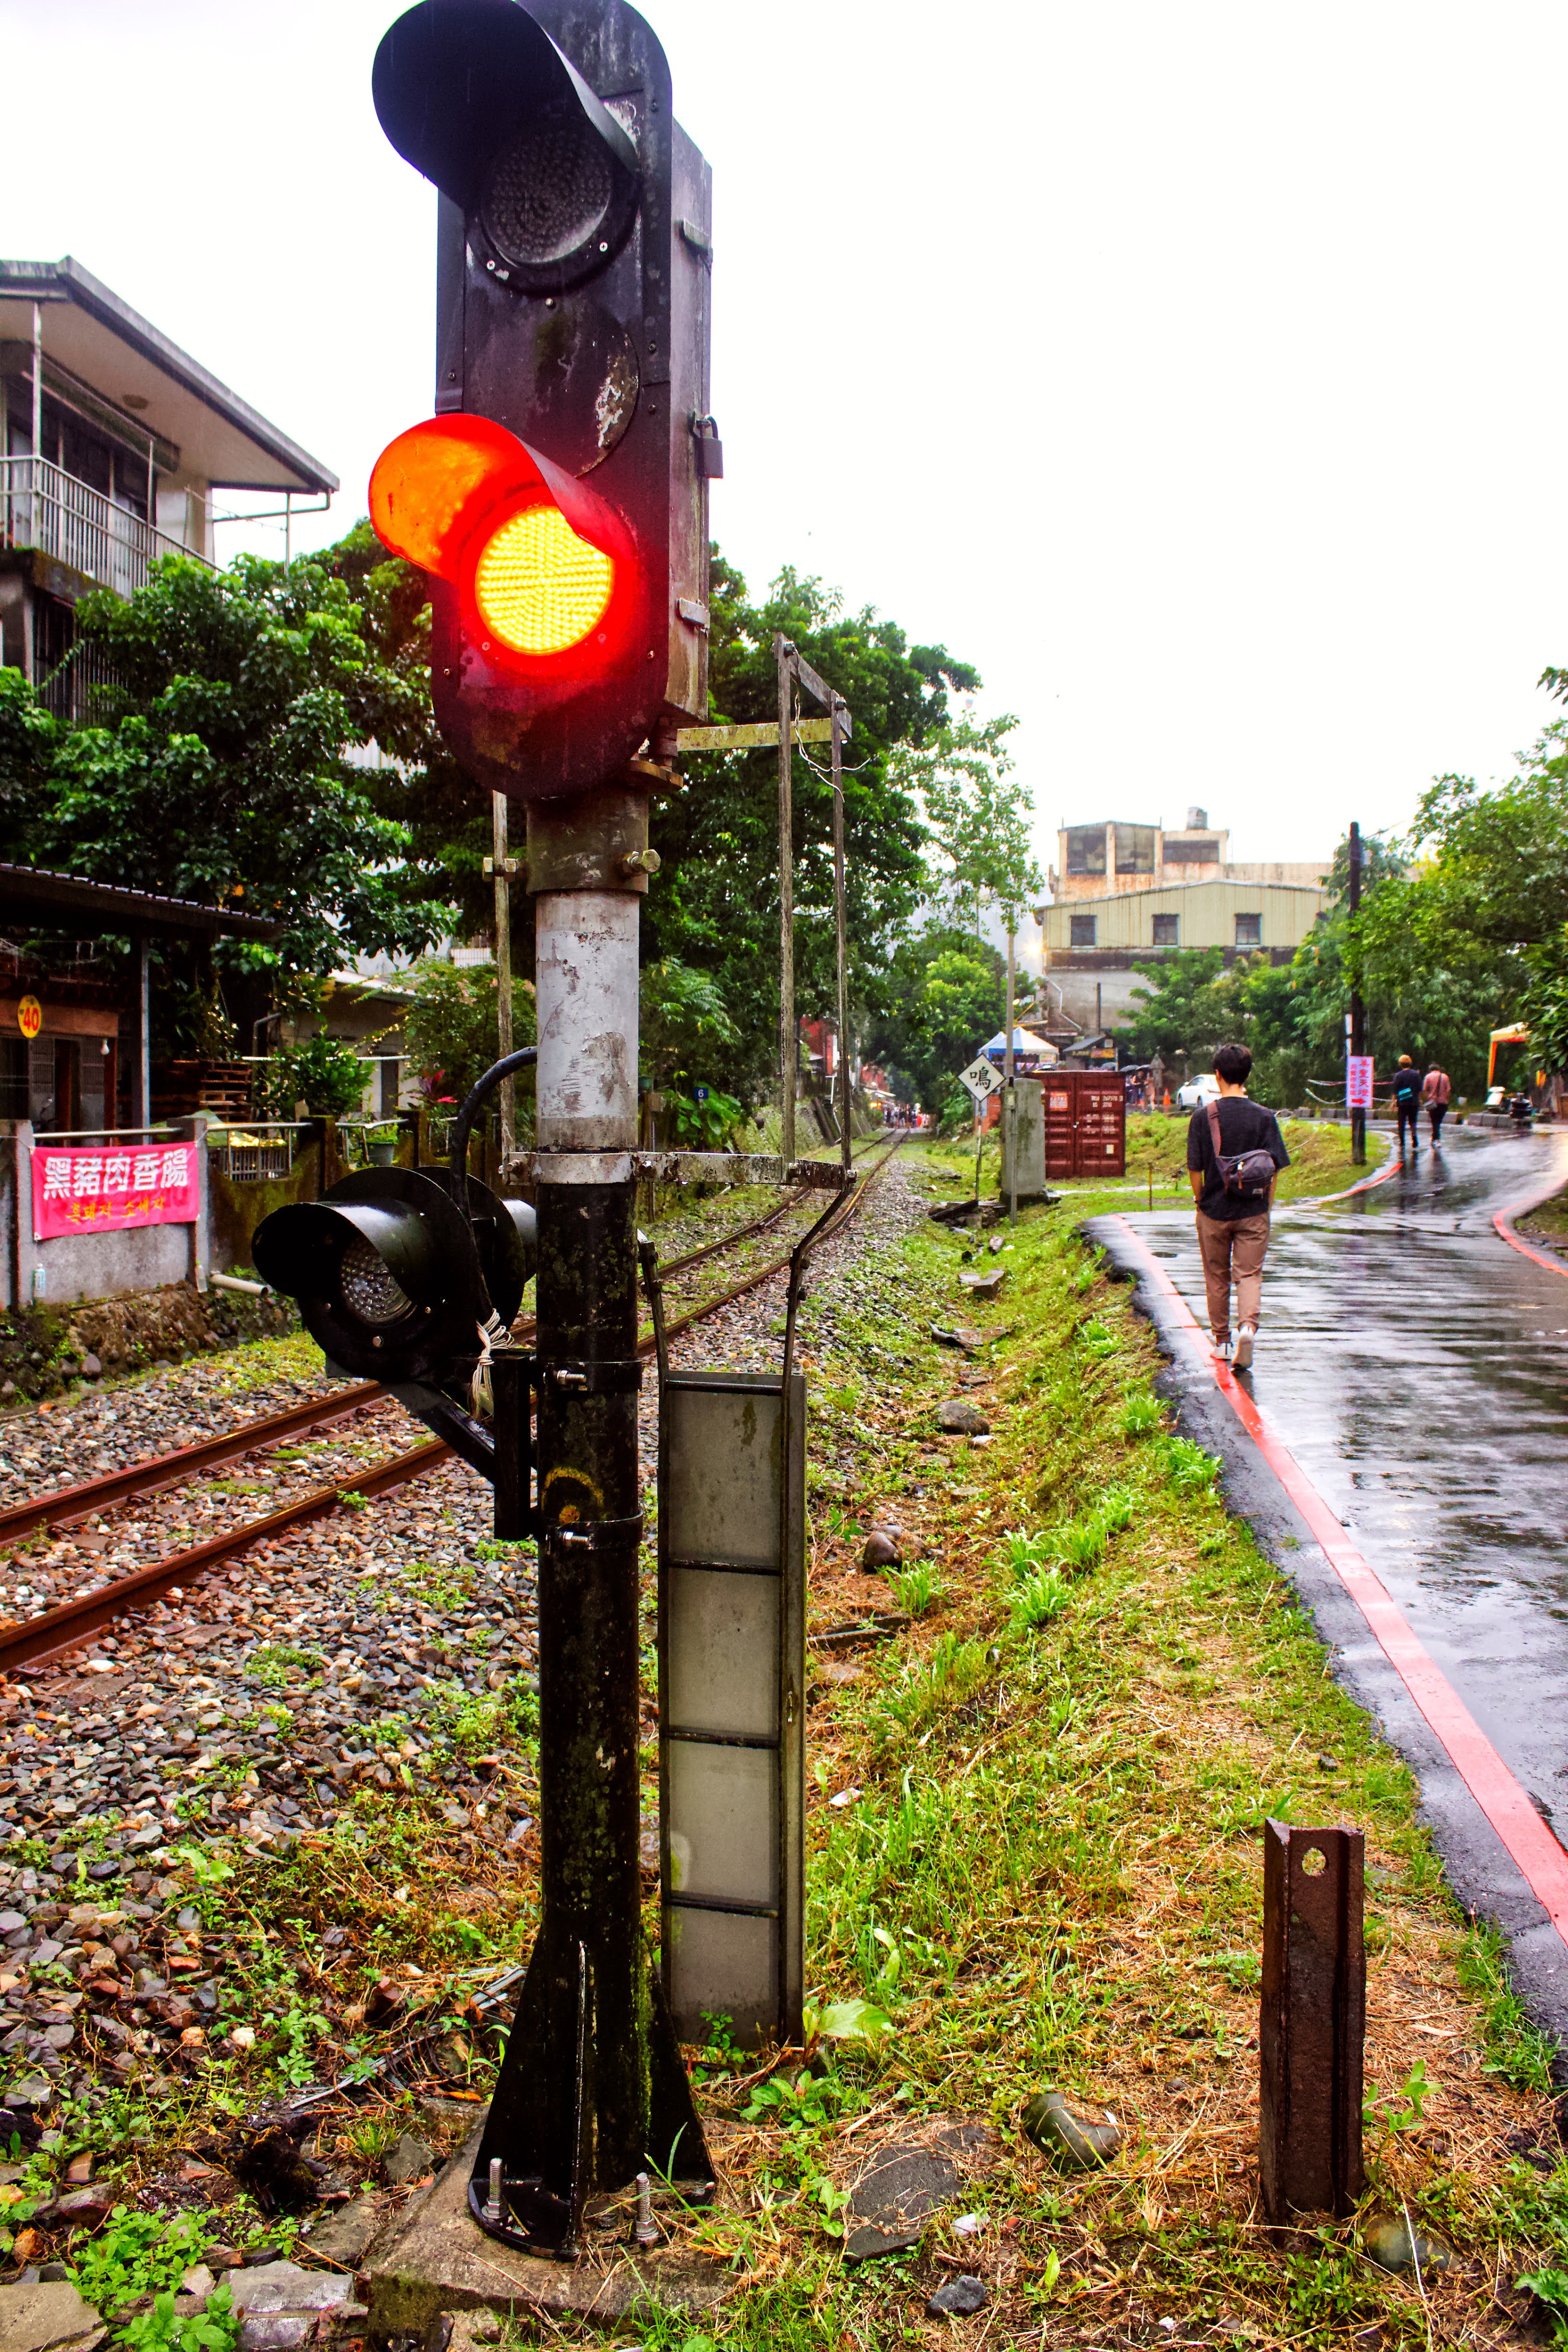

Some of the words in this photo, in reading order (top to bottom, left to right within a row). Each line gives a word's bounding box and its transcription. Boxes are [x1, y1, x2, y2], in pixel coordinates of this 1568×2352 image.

[23, 1007, 39, 1031] 40
[970, 1066, 992, 1090] 鳴
[698, 1089, 704, 1098] 6
[43, 1148, 188, 1200] 黑豬肉香腸
